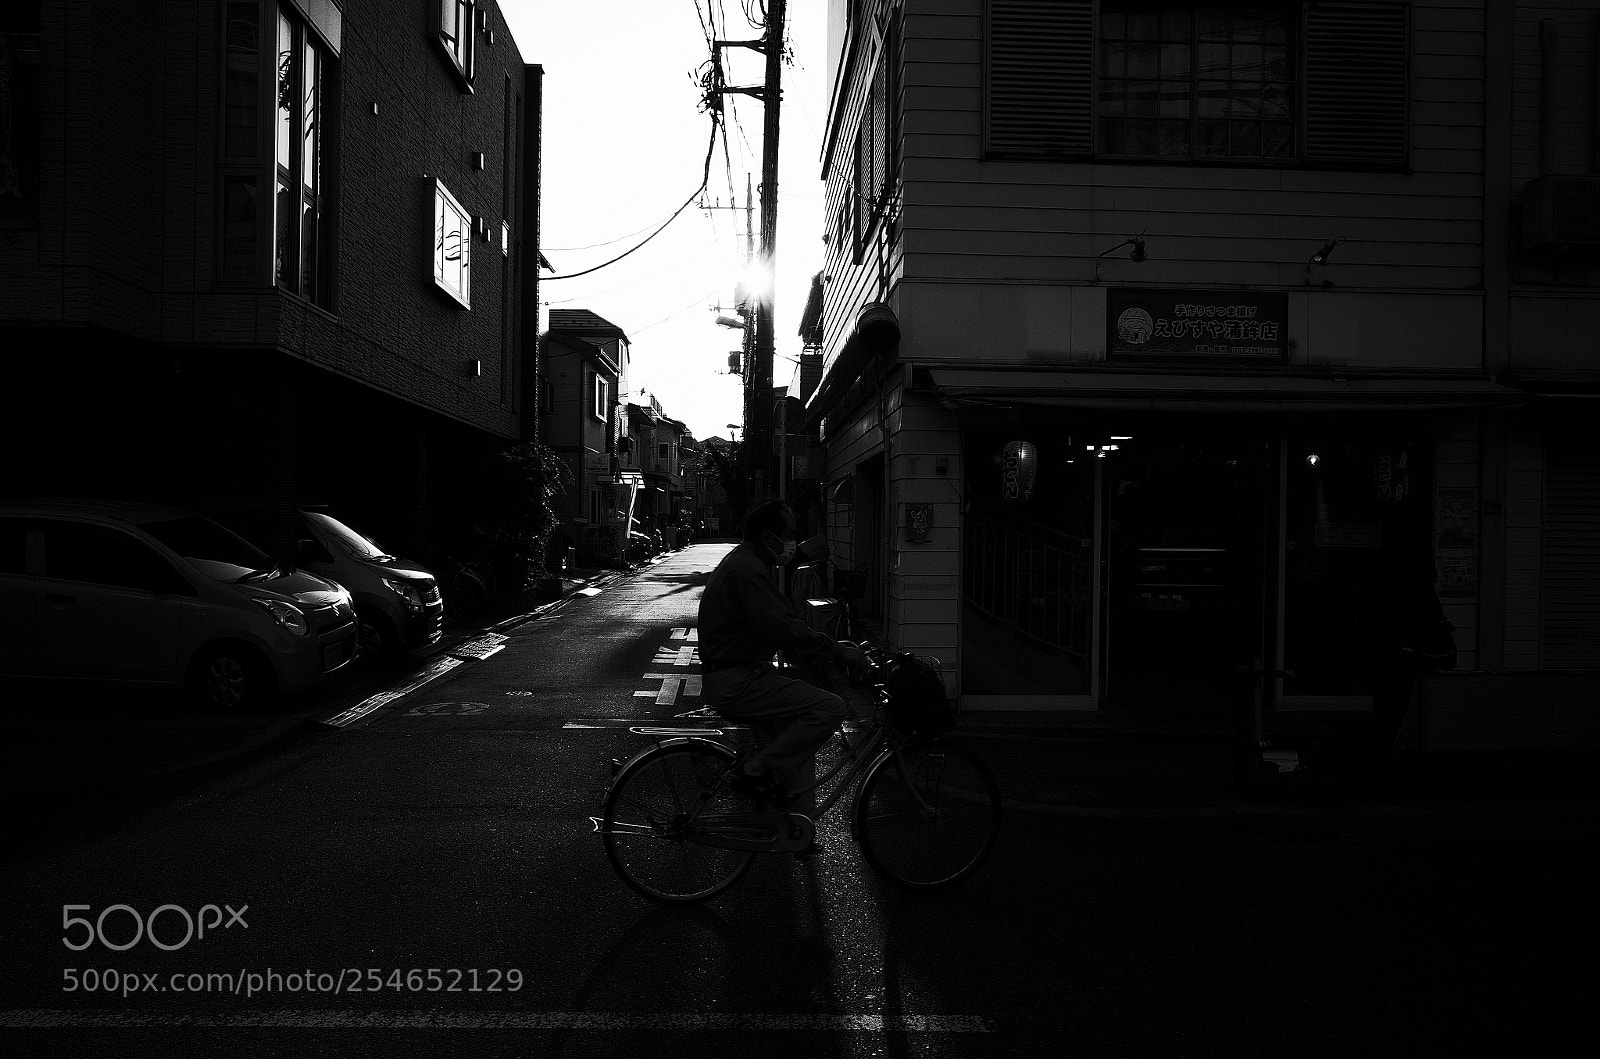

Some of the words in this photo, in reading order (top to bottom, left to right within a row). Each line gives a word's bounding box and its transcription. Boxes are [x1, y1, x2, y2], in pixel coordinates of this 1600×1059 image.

[1174, 304, 1257, 318] 手作りさつま揚げ
[1155, 319, 1279, 340] えびすや蒲鉾店
